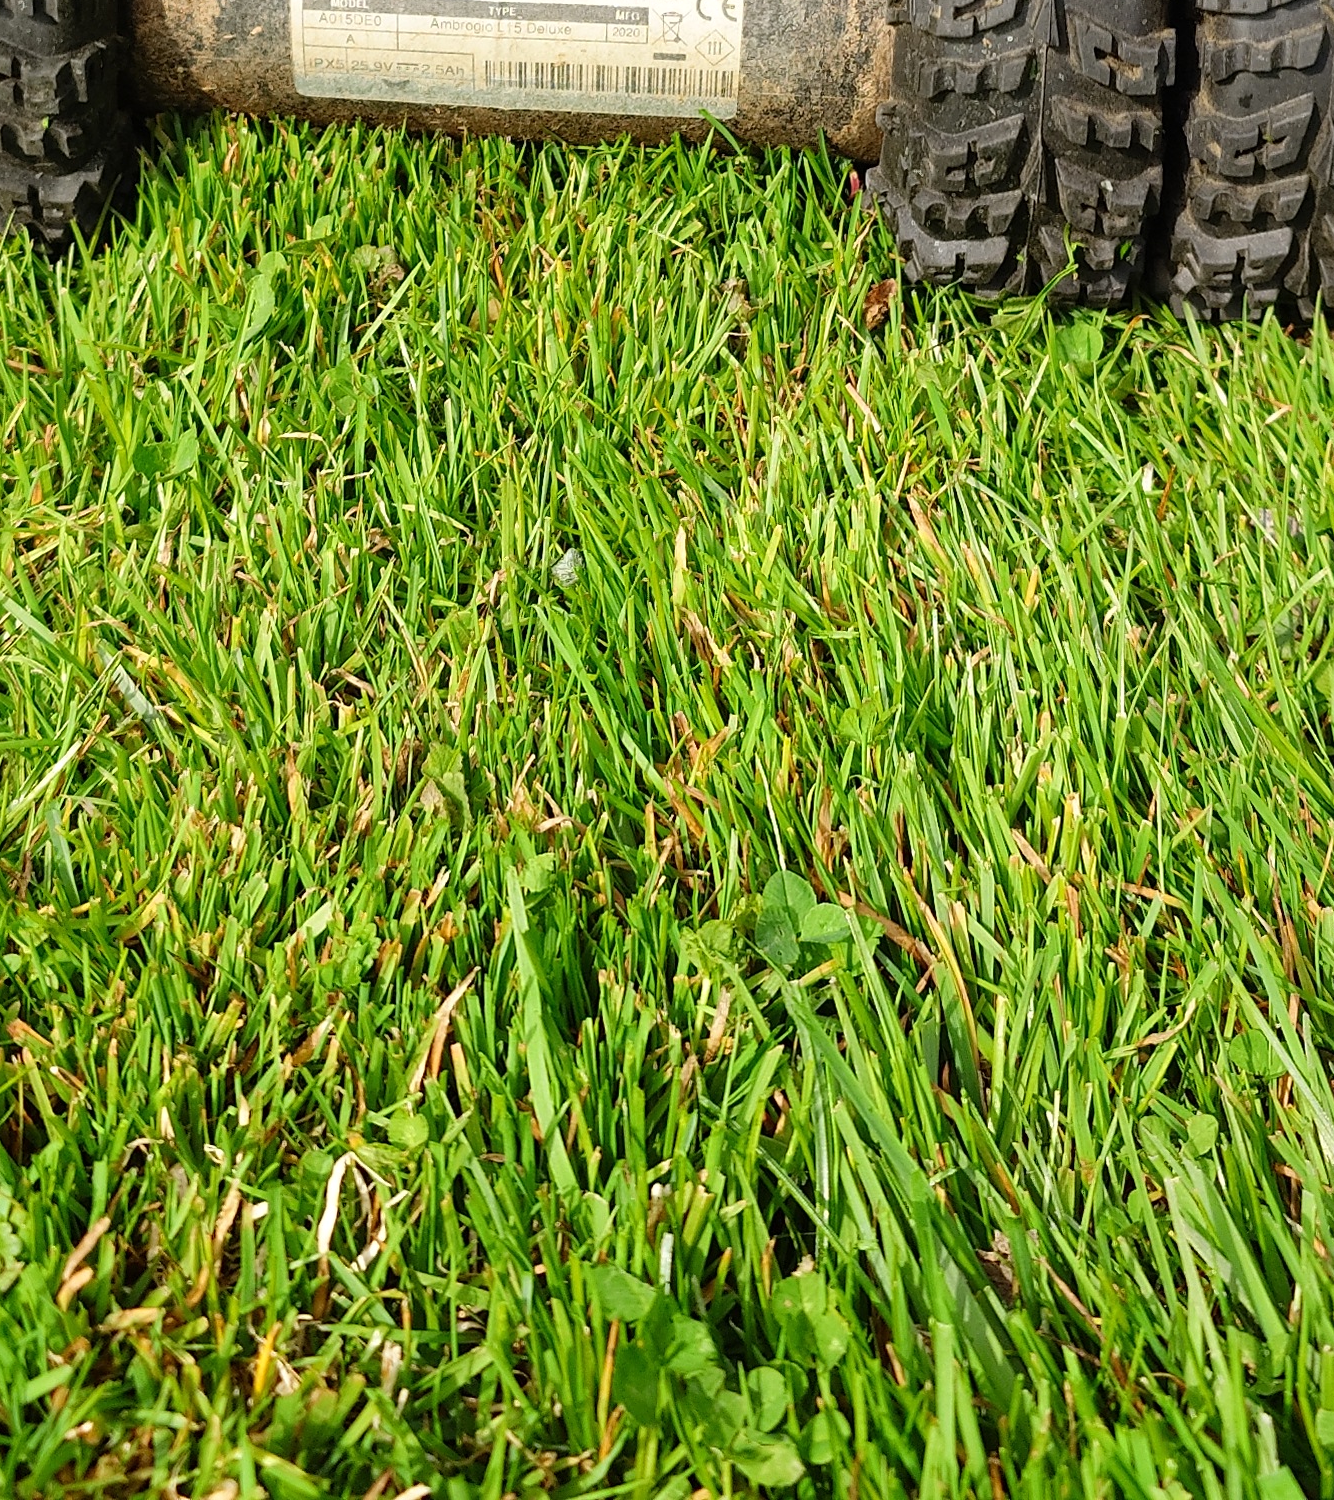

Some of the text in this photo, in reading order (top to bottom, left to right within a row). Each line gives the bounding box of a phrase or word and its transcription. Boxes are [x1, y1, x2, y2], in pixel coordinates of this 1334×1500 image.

[489, 6, 517, 17] TYPE
[430, 18, 493, 34] Ambrogio
[526, 24, 572, 36] Deluxe
[612, 26, 641, 38] 2020
[346, 33, 356, 45] A
